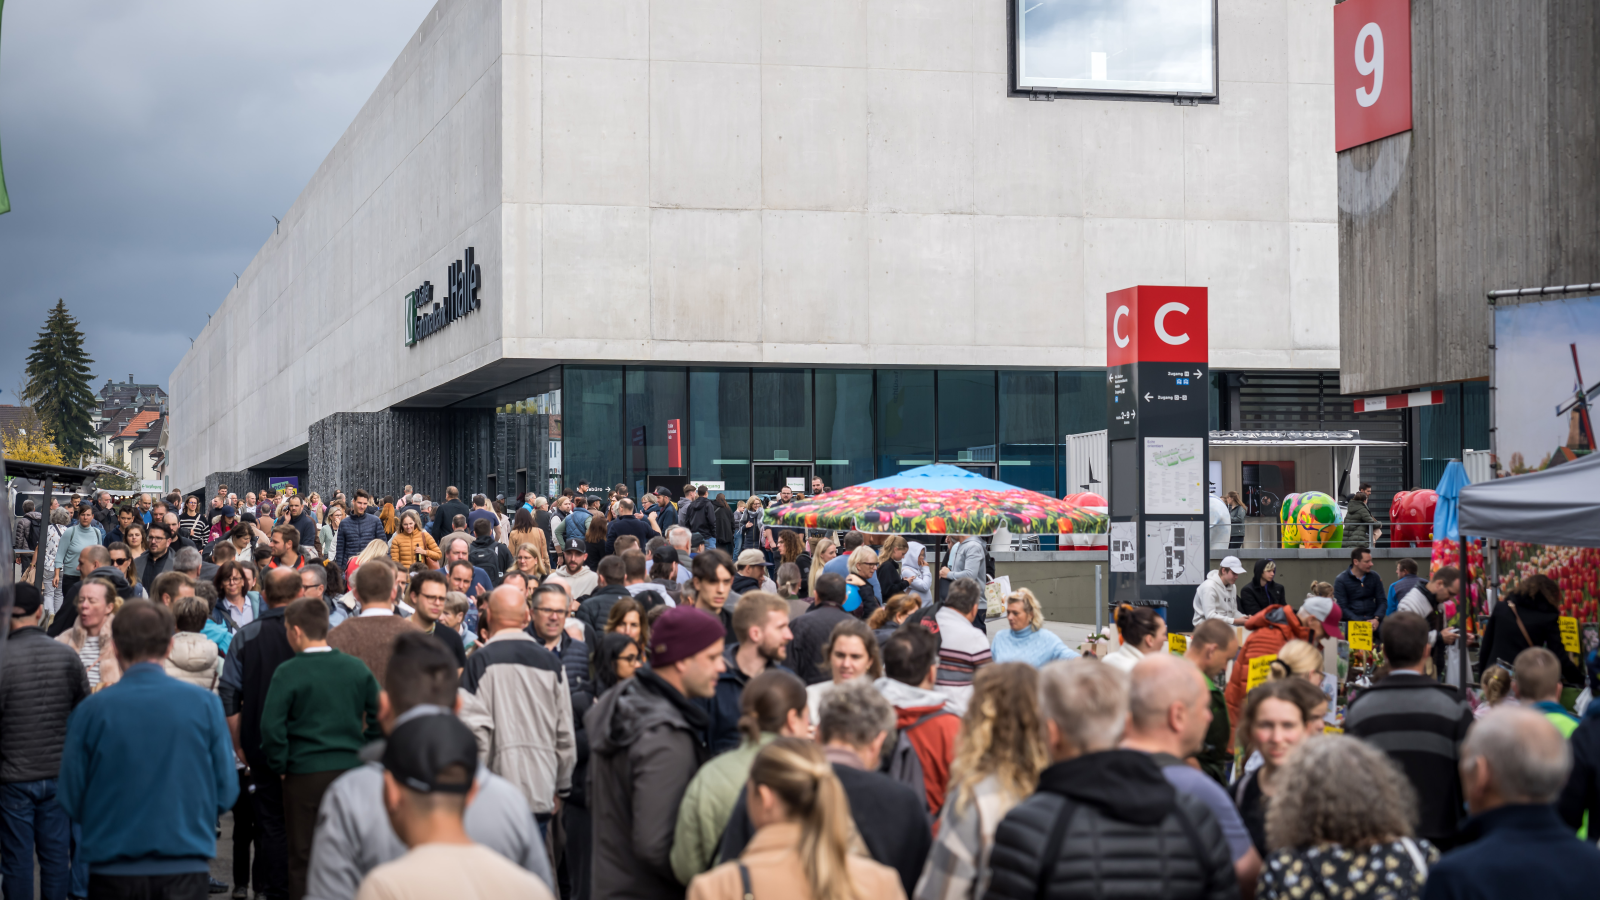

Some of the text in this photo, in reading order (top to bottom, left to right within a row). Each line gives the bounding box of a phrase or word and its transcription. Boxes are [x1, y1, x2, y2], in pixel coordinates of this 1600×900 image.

[1355, 22, 1384, 107] 9
[448, 247, 481, 323] Halle
[1113, 305, 1130, 348] C
[1154, 302, 1190, 345] C
